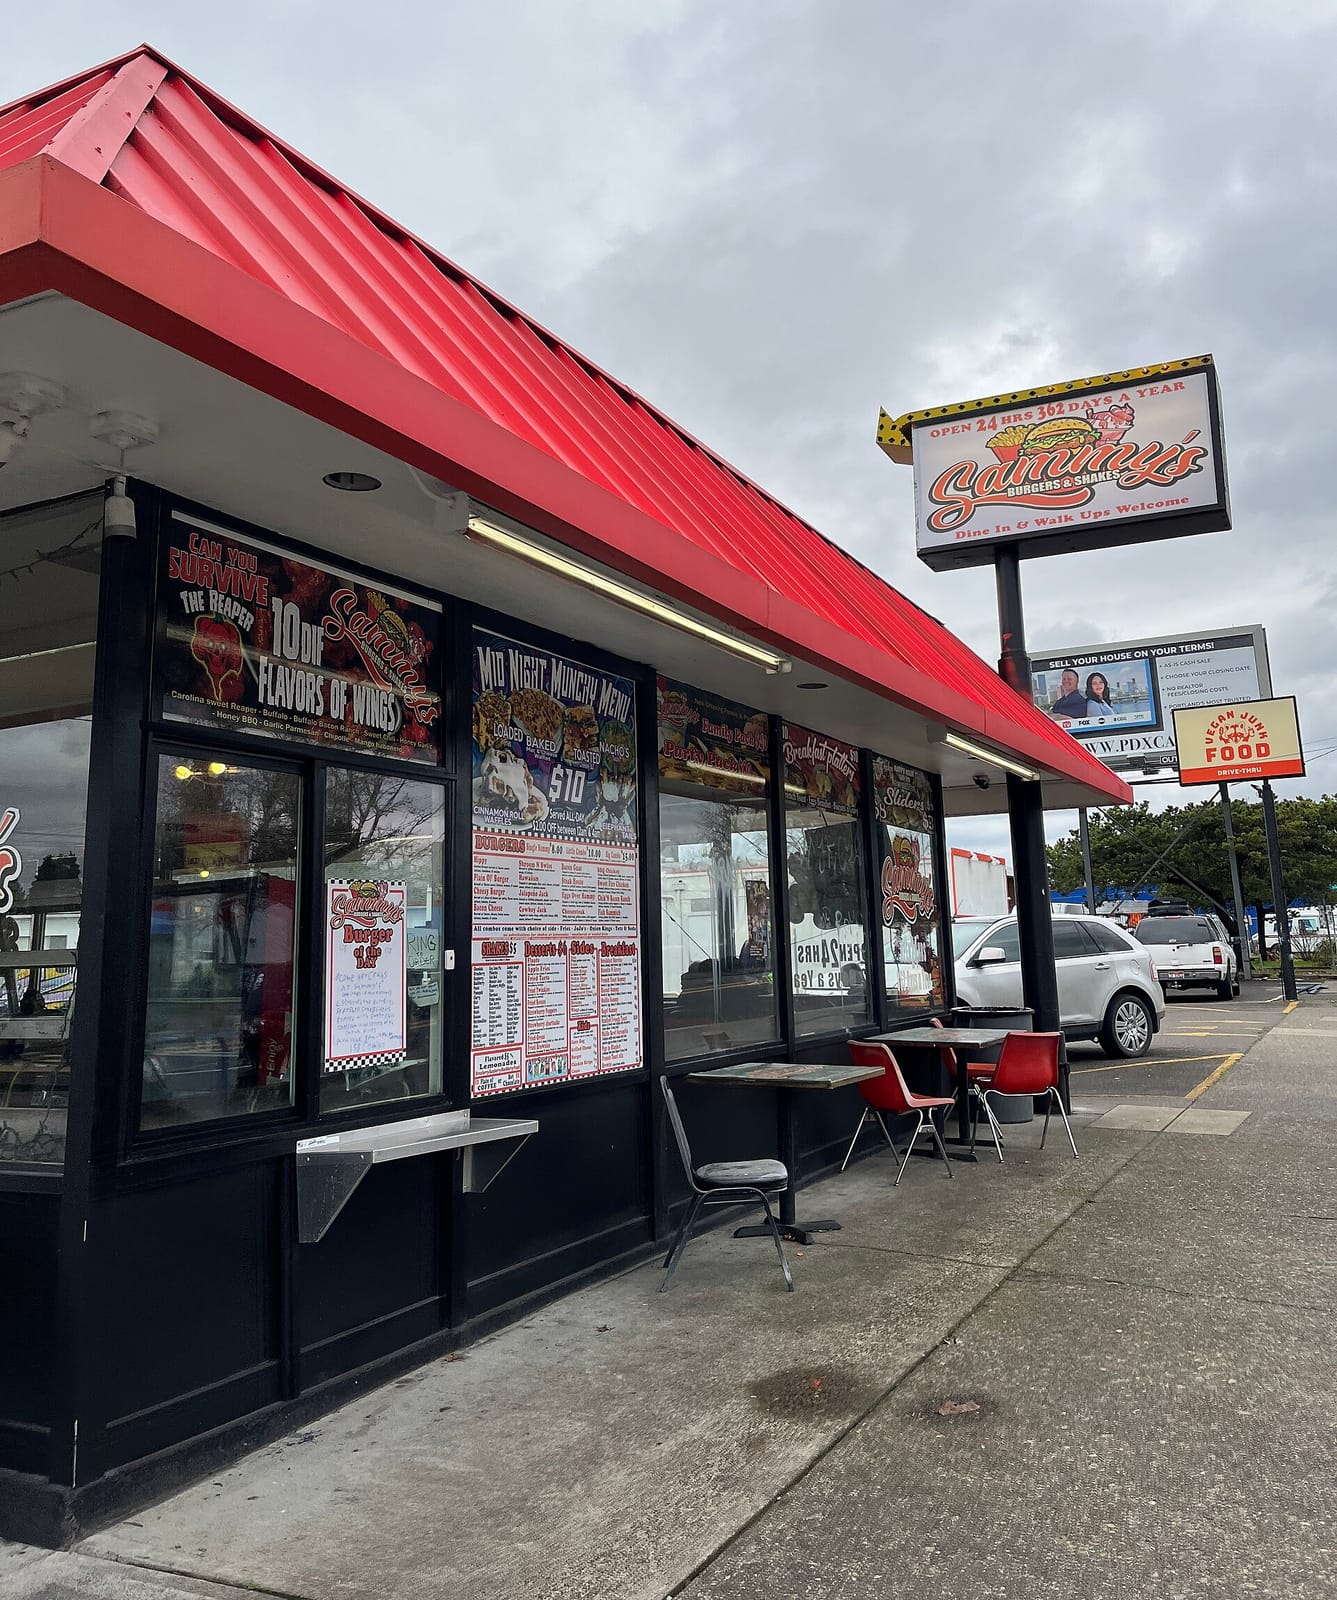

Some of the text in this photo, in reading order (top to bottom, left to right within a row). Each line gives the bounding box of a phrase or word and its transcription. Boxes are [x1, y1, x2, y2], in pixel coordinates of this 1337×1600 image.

[930, 381, 1185, 438] OPEN 24 HRS 362 DAYS A YEAR
[928, 430, 1208, 533] Sammy's
[1007, 469, 1121, 498] BURGERS & SHAKES
[955, 496, 1189, 540] Dine In & Walk Ups Welcome
[188, 532, 258, 573] CAN YOU
[168, 546, 268, 606] SURVIVE
[180, 590, 255, 632] THE REAPER
[271, 597, 325, 667] 10 DIF
[322, 588, 440, 727] Sammy's
[1049, 642, 1215, 669] SELL YOUR HOUSE ON YOUR TERMS!
[258, 656, 326, 718] FLAVORS
[330, 679, 348, 721] OF
[477, 646, 632, 723] MID NIGHT MUNCHY MENU
[1168, 689, 1208, 697] FEES/CLOSING
[171, 690, 205, 703] Carolina
[206, 698, 229, 709] sweet
[231, 702, 257, 714] Reaper
[263, 708, 288, 720] Buffalo
[294, 715, 318, 726] Buffalo
[319, 720, 339, 730] Bacon
[340, 725, 359, 735] Ranch
[216, 710, 240, 722] Honey
[242, 716, 258, 726] BBQ
[264, 720, 284, 730] Garlic
[285, 724, 319, 736] Parmesan
[493, 724, 524, 742] LOADED
[702, 717, 733, 744] Family
[1205, 710, 1269, 745] VEGAN JUNK
[526, 736, 556, 752] BAKED
[600, 742, 630, 758] NACHO'S
[664, 740, 704, 765] Party
[707, 752, 737, 770] Pack
[783, 736, 827, 765] Breakfast
[1206, 742, 1271, 763] FOOD
[574, 748, 600, 765] TOASTED
[1217, 767, 1262, 776] DRIVE-THRU
[550, 764, 586, 804] $10
[884, 787, 924, 811] Sliders
[473, 806, 524, 821] CINNAMON ROLL
[484, 815, 512, 827] WAFFLES
[550, 808, 566, 820] Served
[547, 822, 557, 832] OFF
[557, 824, 576, 835] between
[475, 834, 526, 854] BURGERS
[882, 856, 934, 926] Sammy's
[330, 893, 404, 929] Sammy's
[343, 924, 393, 947] Burger
[407, 932, 436, 952] RING
[571, 940, 594, 955] Sides
[354, 946, 382, 957] of the
[482, 941, 509, 956] SHAKES
[510, 941, 516, 954] $5
[524, 941, 556, 958] Desserts
[601, 941, 636, 957] Breakfast
[356, 957, 377, 969] DAY
[409, 955, 436, 968] ORDER
[266, 1038, 278, 1071] Enjoy
[480, 1060, 517, 1070] Lemonades
[478, 1082, 496, 1090] COFFEE
